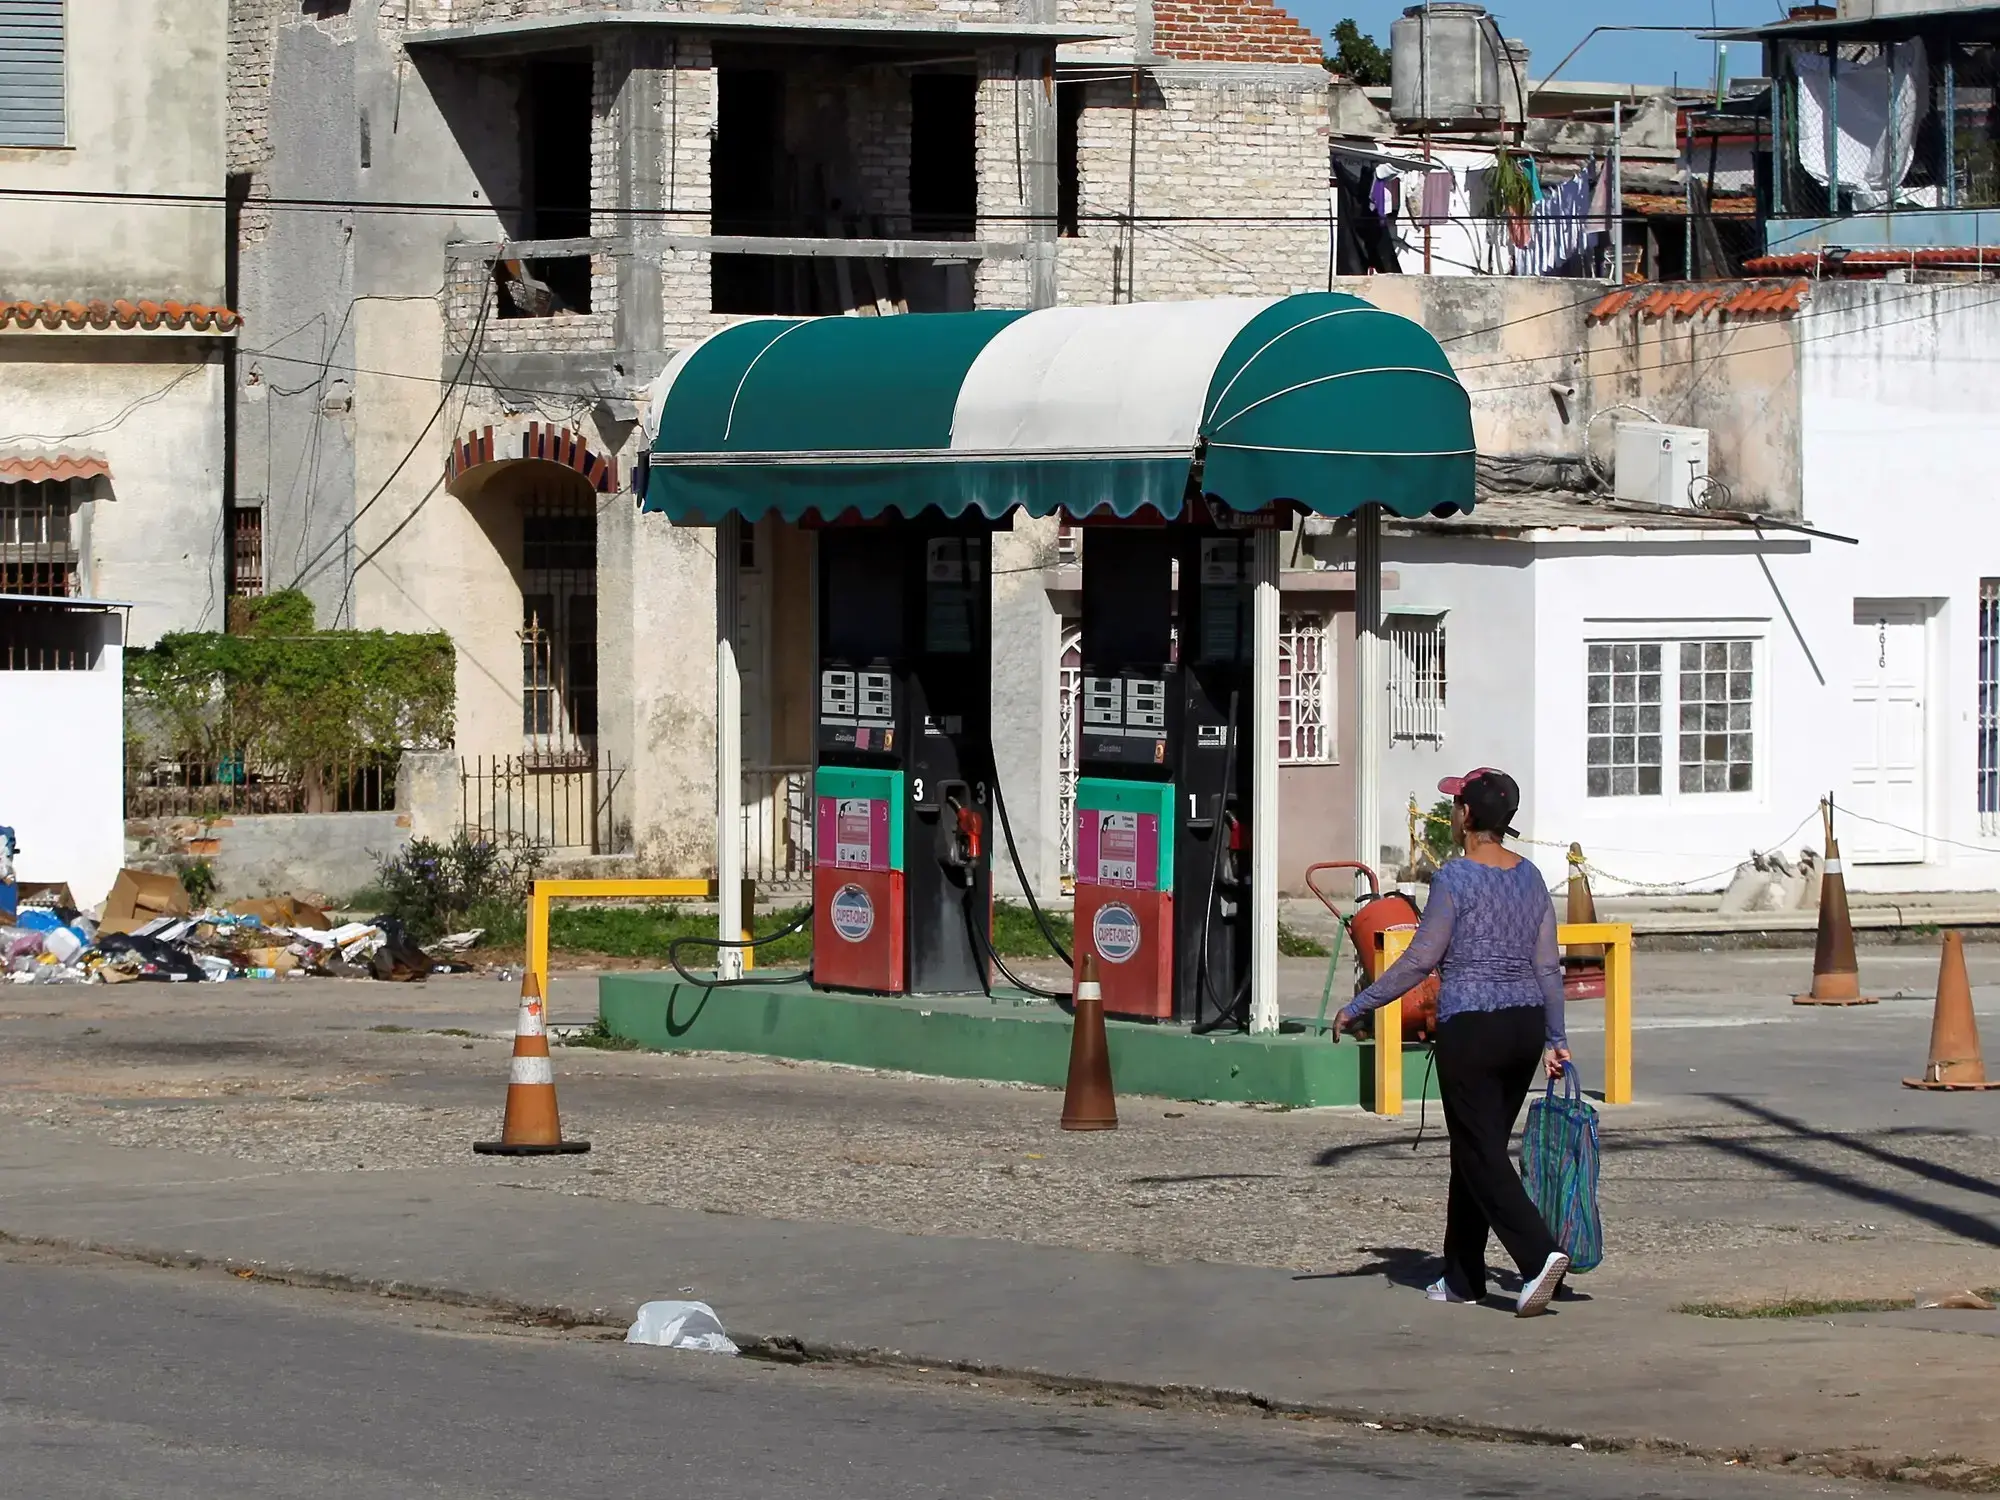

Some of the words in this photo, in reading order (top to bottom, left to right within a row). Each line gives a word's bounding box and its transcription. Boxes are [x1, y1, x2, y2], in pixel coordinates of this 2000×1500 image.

[913, 778, 924, 802] 3
[976, 781, 987, 804] 3
[820, 803, 827, 817] 4
[1188, 794, 1197, 818] 1
[882, 807, 888, 822] 3
[1079, 817, 1085, 829] 2
[1151, 820, 1158, 832] 1
